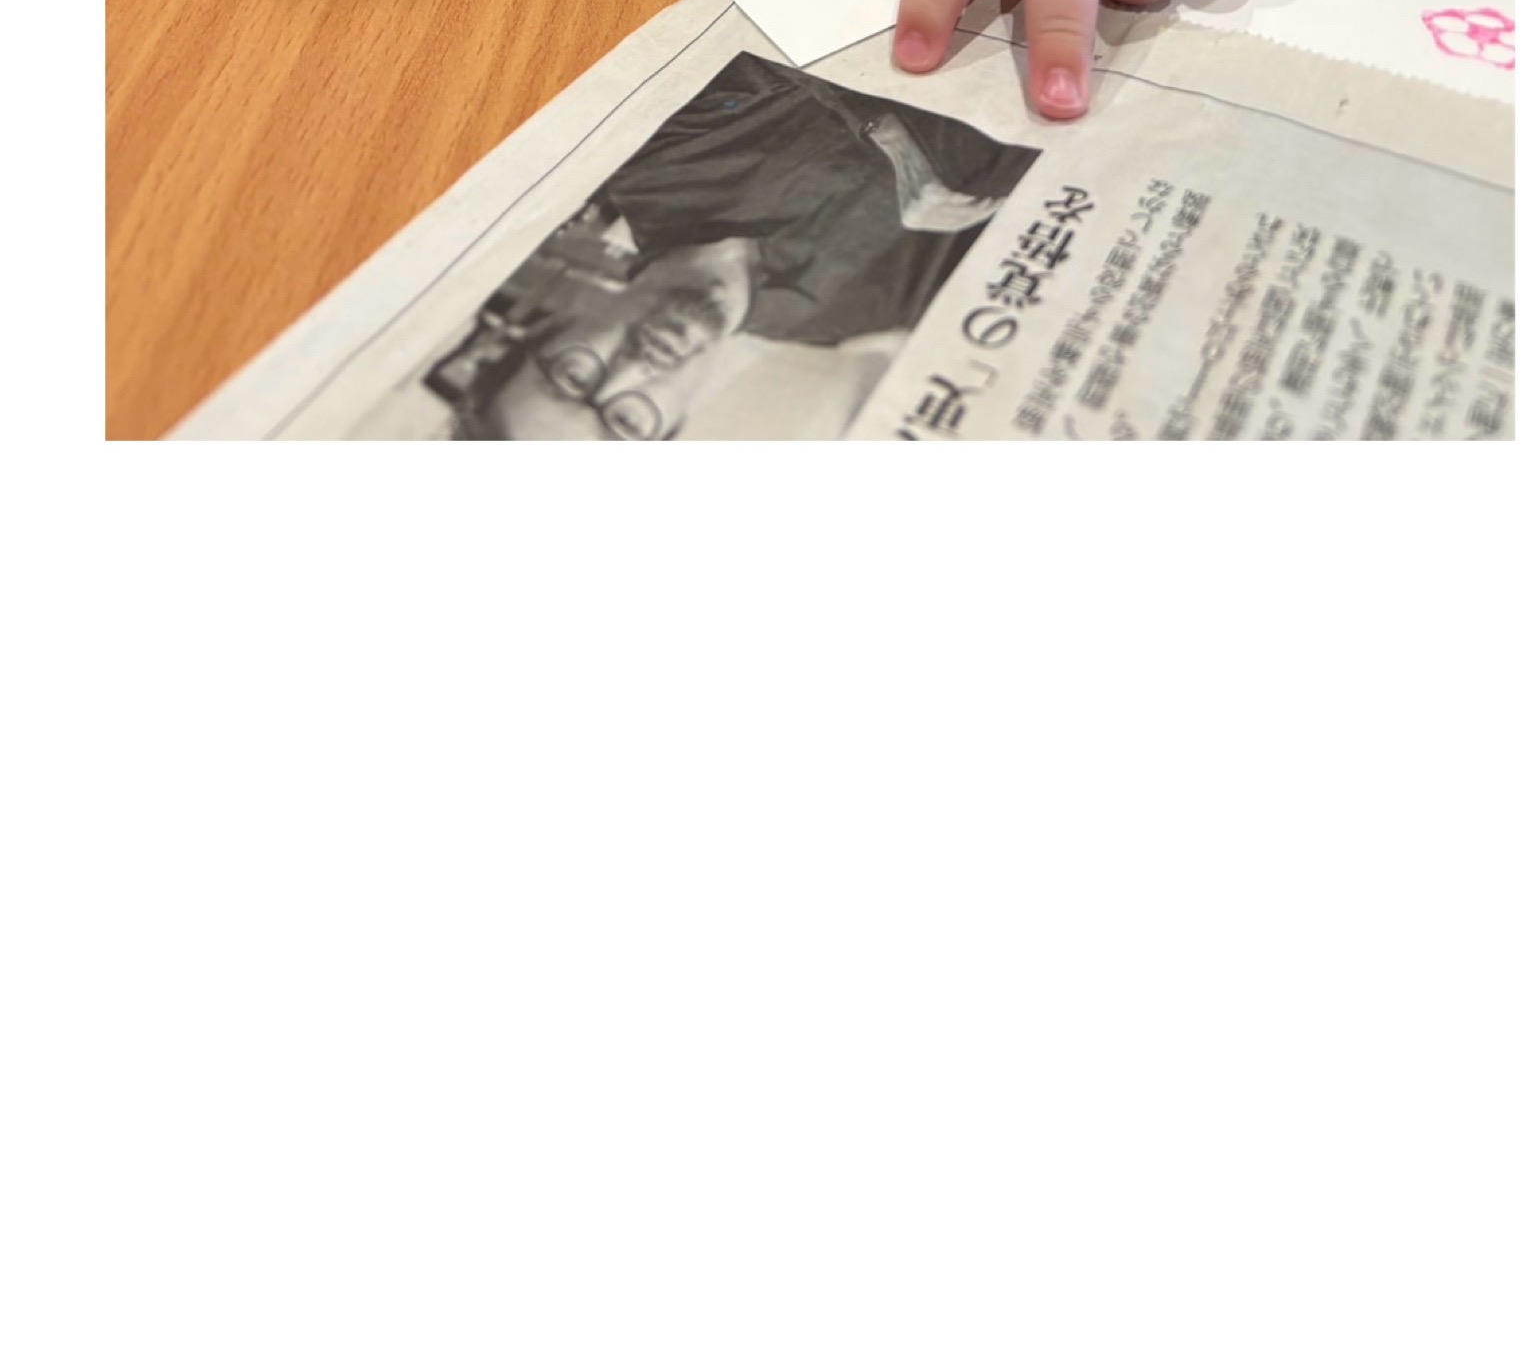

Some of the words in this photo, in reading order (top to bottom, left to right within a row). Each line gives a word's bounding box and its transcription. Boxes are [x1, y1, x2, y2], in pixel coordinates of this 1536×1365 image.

[896, 185, 1094, 440] 更」の覚悟を
